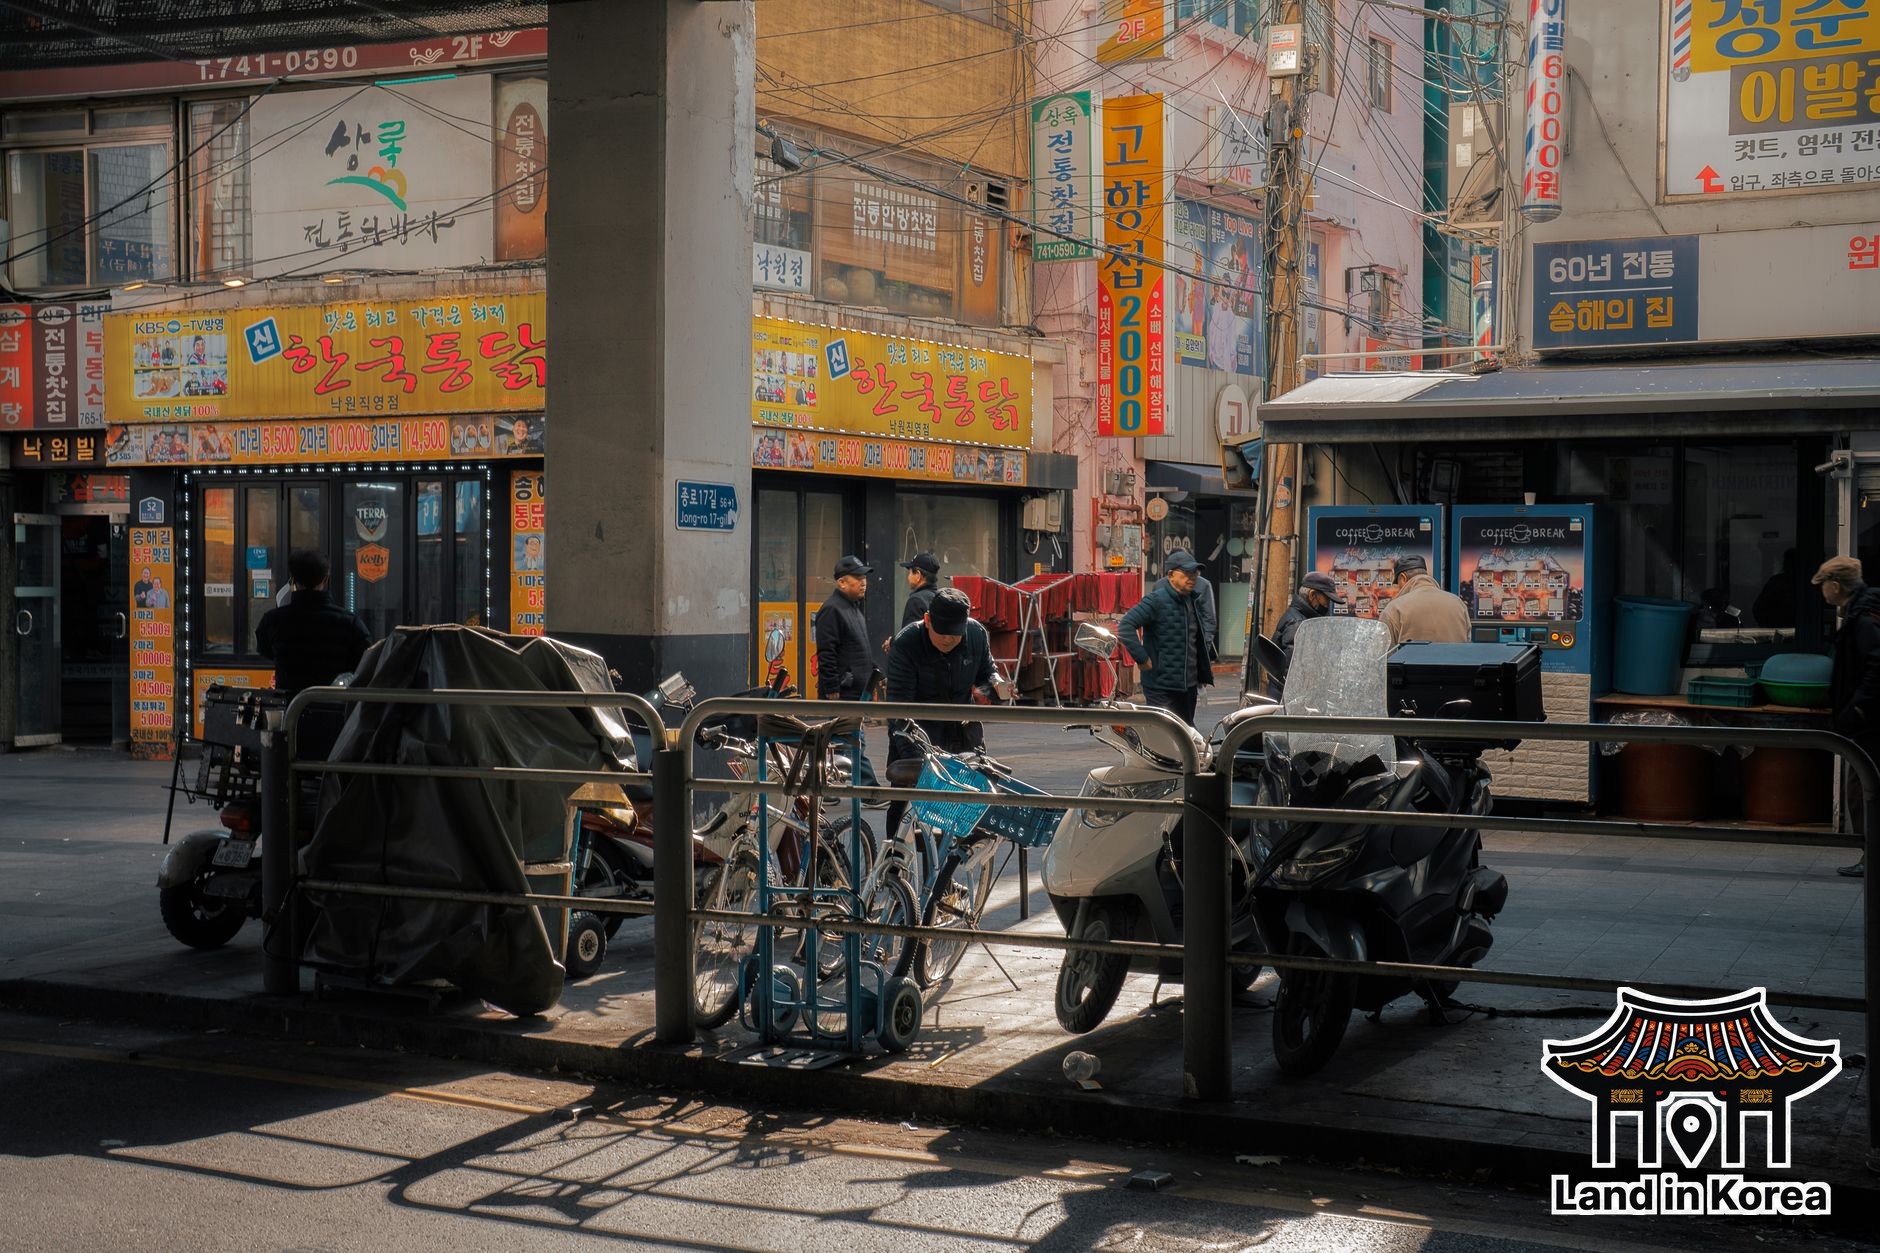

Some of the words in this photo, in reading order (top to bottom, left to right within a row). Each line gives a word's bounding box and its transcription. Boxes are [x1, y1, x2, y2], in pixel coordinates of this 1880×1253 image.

[1116, 20, 1145, 43] 2F
[452, 36, 483, 61] 2F
[1739, 55, 1880, 124] 이발
[1047, 106, 1078, 127] 상록
[325, 120, 407, 171] 상록
[1850, 129, 1880, 152] 전
[515, 114, 537, 205] 전통찻집
[1047, 130, 1078, 235] 전통찻집
[1103, 125, 1150, 289] 고향집
[973, 218, 984, 282] 통찻집
[1549, 252, 1612, 283] 60년
[1622, 250, 1675, 280] 전통
[136, 321, 165, 334] KBS
[1548, 298, 1633, 333] 송해의
[1645, 296, 1674, 328] 집
[253, 325, 276, 356] 신
[832, 345, 846, 372] 신
[1119, 295, 1141, 431] 2000
[1, 331, 23, 424] 삼계탕
[45, 328, 68, 423] 전통찻집
[850, 356, 1019, 431] 한국통닭
[681, 487, 717, 509] 종로17길
[356, 508, 386, 519] TERRA
[681, 511, 708, 526] Jong-ro
[133, 531, 170, 545] 송해길
[1384, 528, 1415, 539] BREAK
[1532, 528, 1565, 539] BREAK
[360, 554, 386, 567] Kelly
